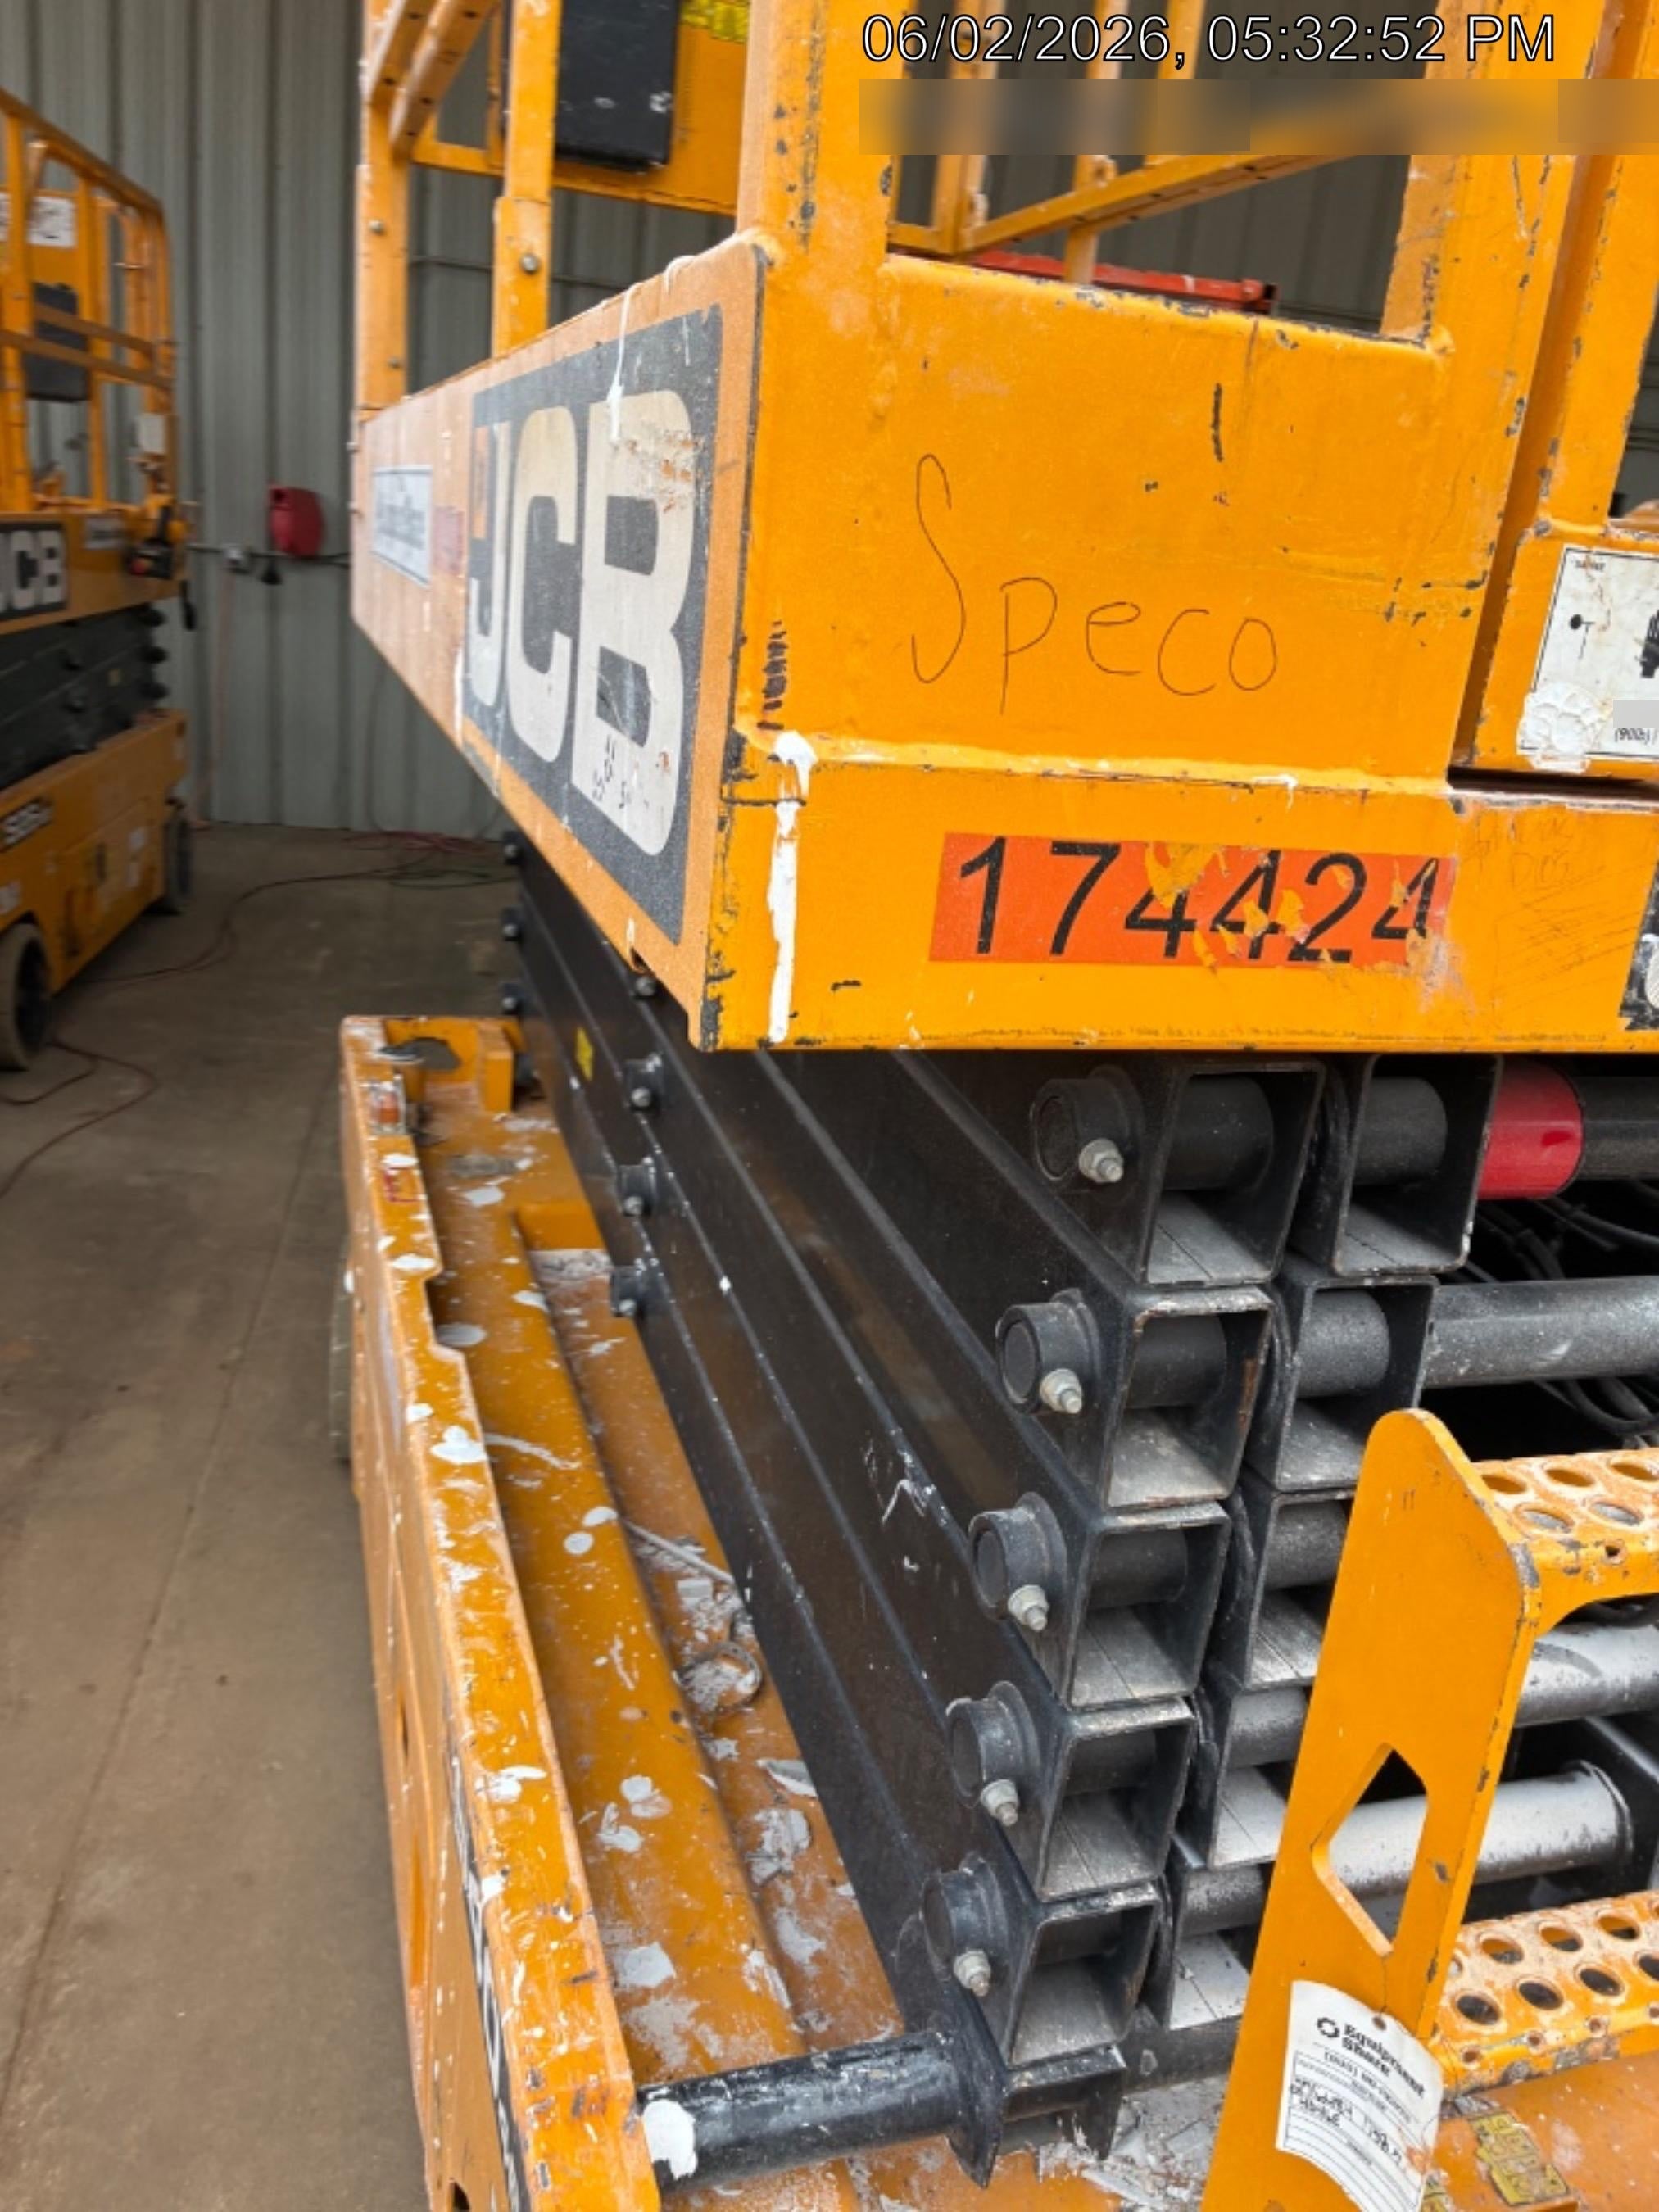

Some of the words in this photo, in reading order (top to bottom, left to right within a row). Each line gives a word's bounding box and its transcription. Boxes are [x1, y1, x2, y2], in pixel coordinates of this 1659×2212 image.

[0, 530, 66, 613] CB
[469, 389, 697, 857] JCB
[911, 453, 1278, 716] Speco
[959, 836, 1440, 963] 174424
[1342, 2037, 1390, 2077] Share
[1344, 2024, 1425, 2098] Equipment
